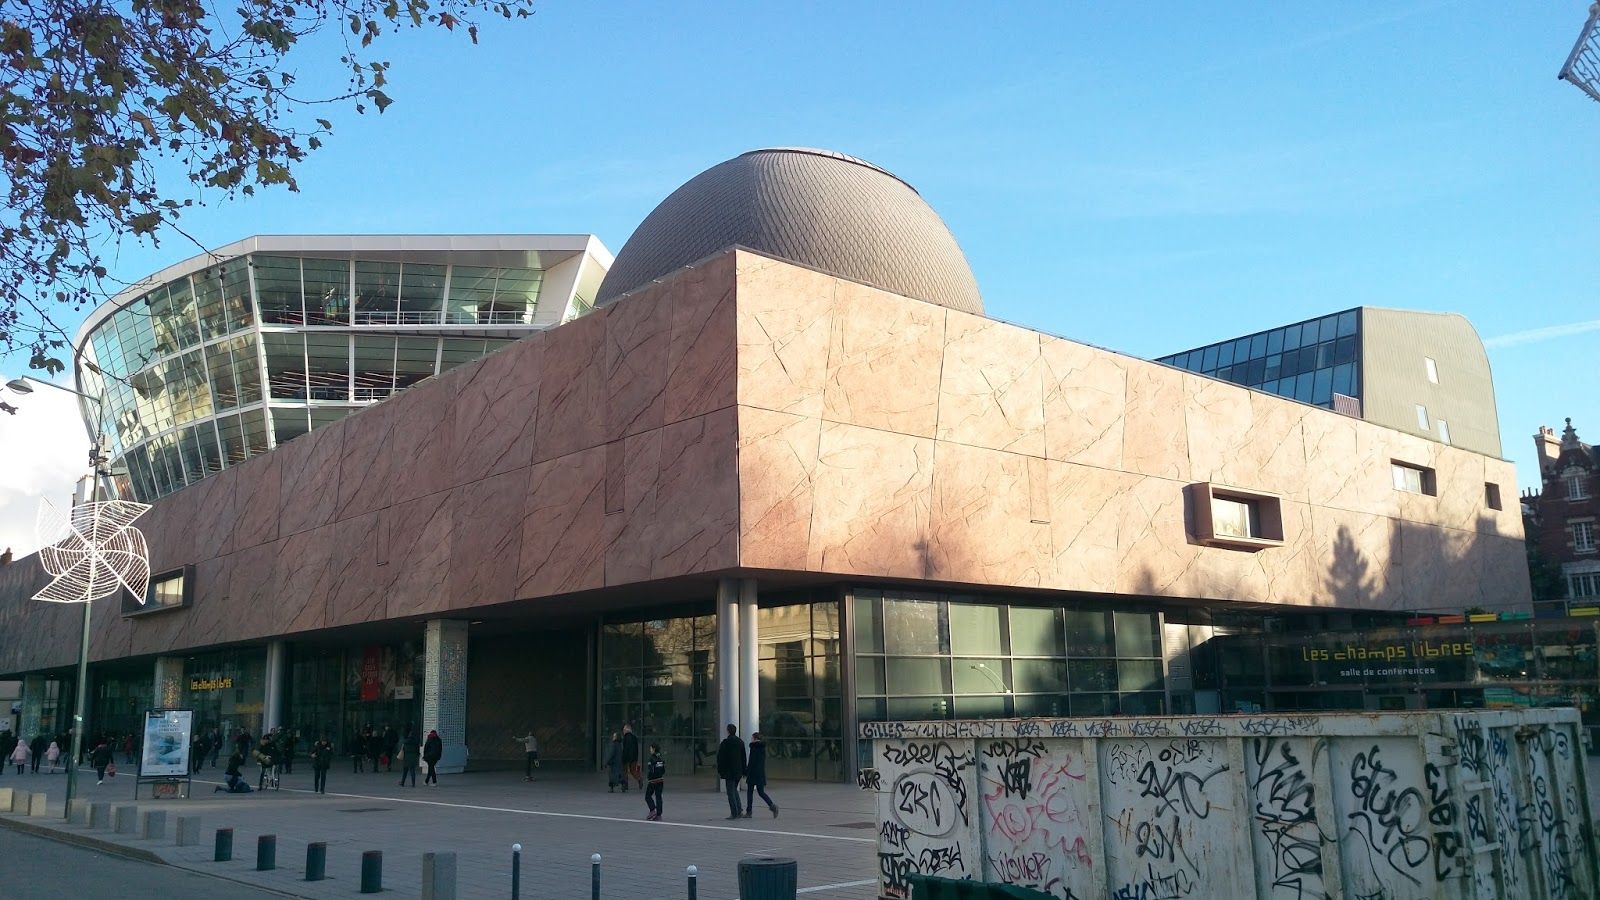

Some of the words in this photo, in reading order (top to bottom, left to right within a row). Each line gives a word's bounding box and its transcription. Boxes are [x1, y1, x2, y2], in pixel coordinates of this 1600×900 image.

[1302, 646, 1328, 661] les
[1334, 644, 1406, 662] champs
[1411, 641, 1474, 657] libres
[1340, 668, 1361, 677] salle
[1363, 667, 1374, 676] de
